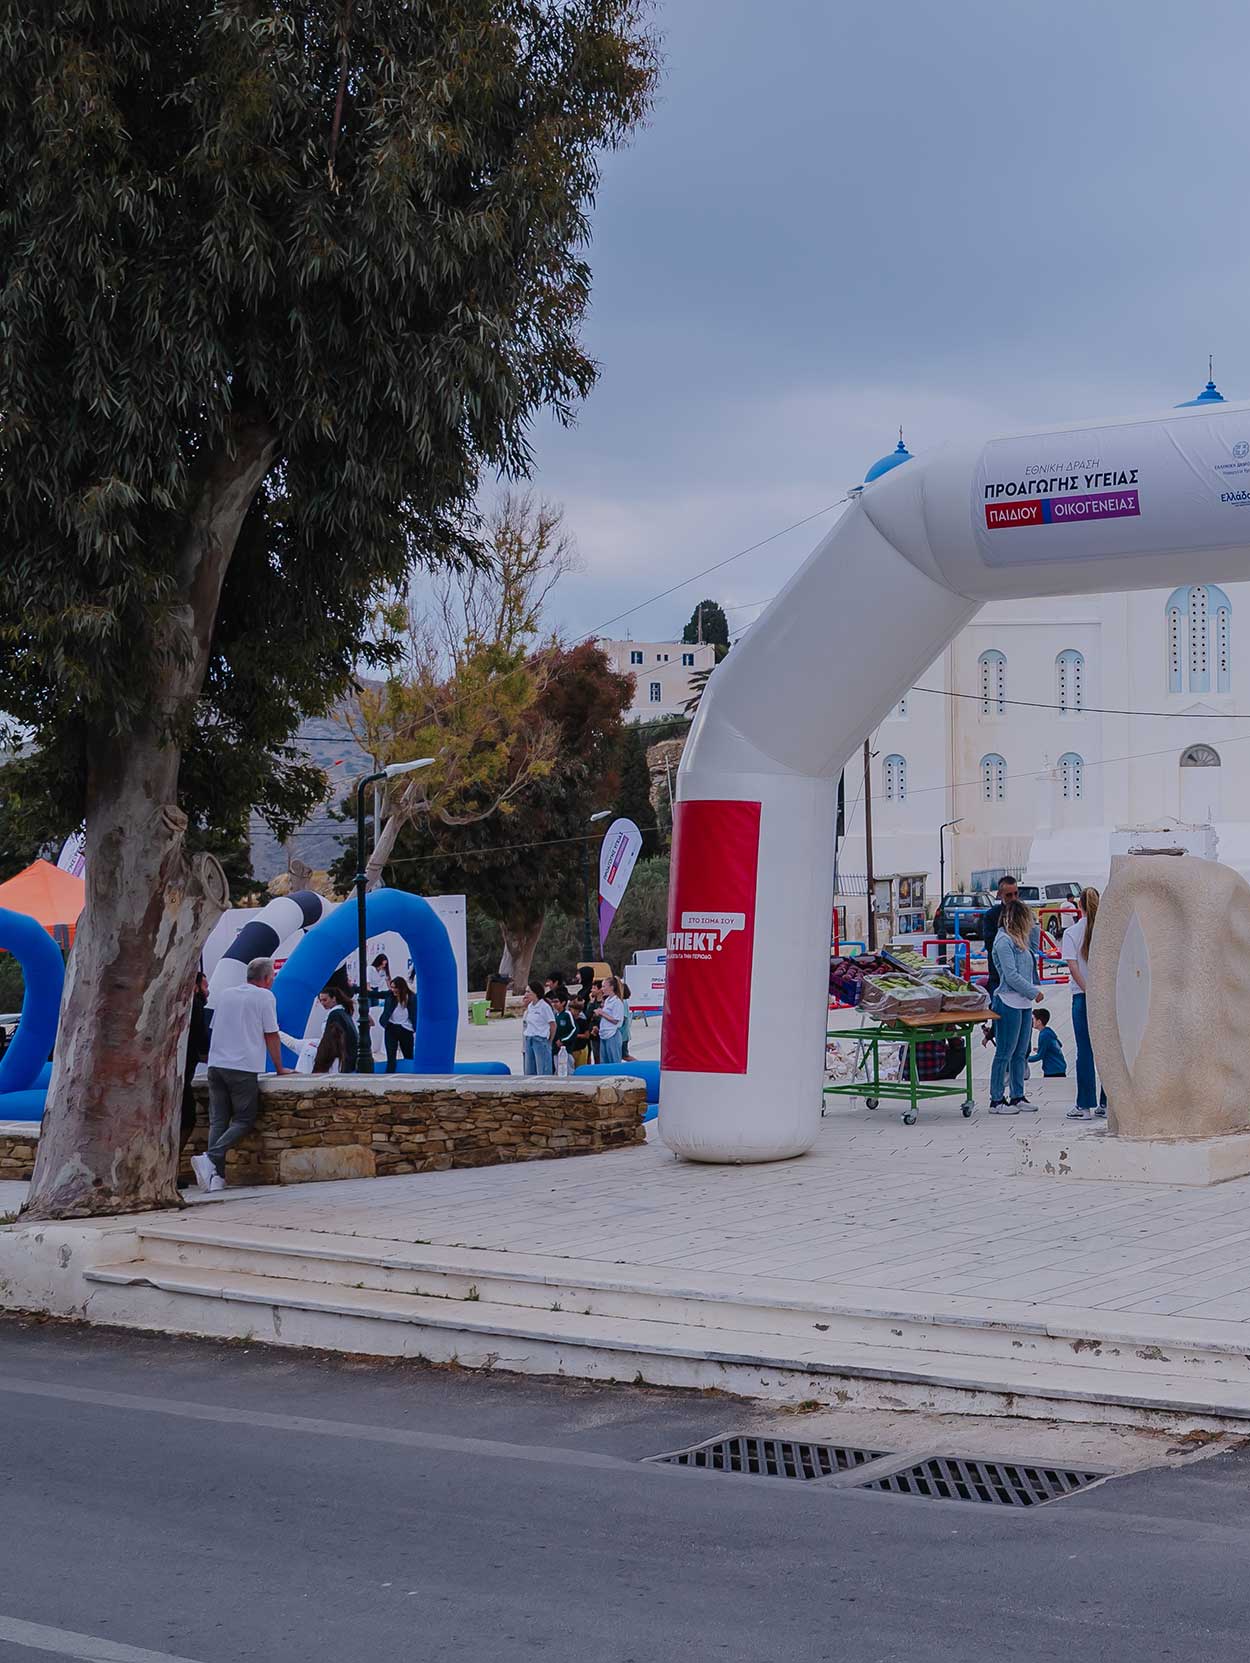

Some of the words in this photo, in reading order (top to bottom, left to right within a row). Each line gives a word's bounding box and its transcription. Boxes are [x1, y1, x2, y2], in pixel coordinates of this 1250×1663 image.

[1025, 463, 1064, 476] ΕΘΝΙΚΗ
[1065, 458, 1101, 472] ΔΡΑΣΗ
[984, 476, 1079, 499] ΠΡΟΑΓΩΓΗΣ
[1084, 469, 1139, 489] ΥΓΕΙΑΣ
[989, 506, 1038, 523] ΠΑΙΔΙΟΥ
[1054, 497, 1136, 516] ΟΙΚΟΓΕΝΕΙΑΣ
